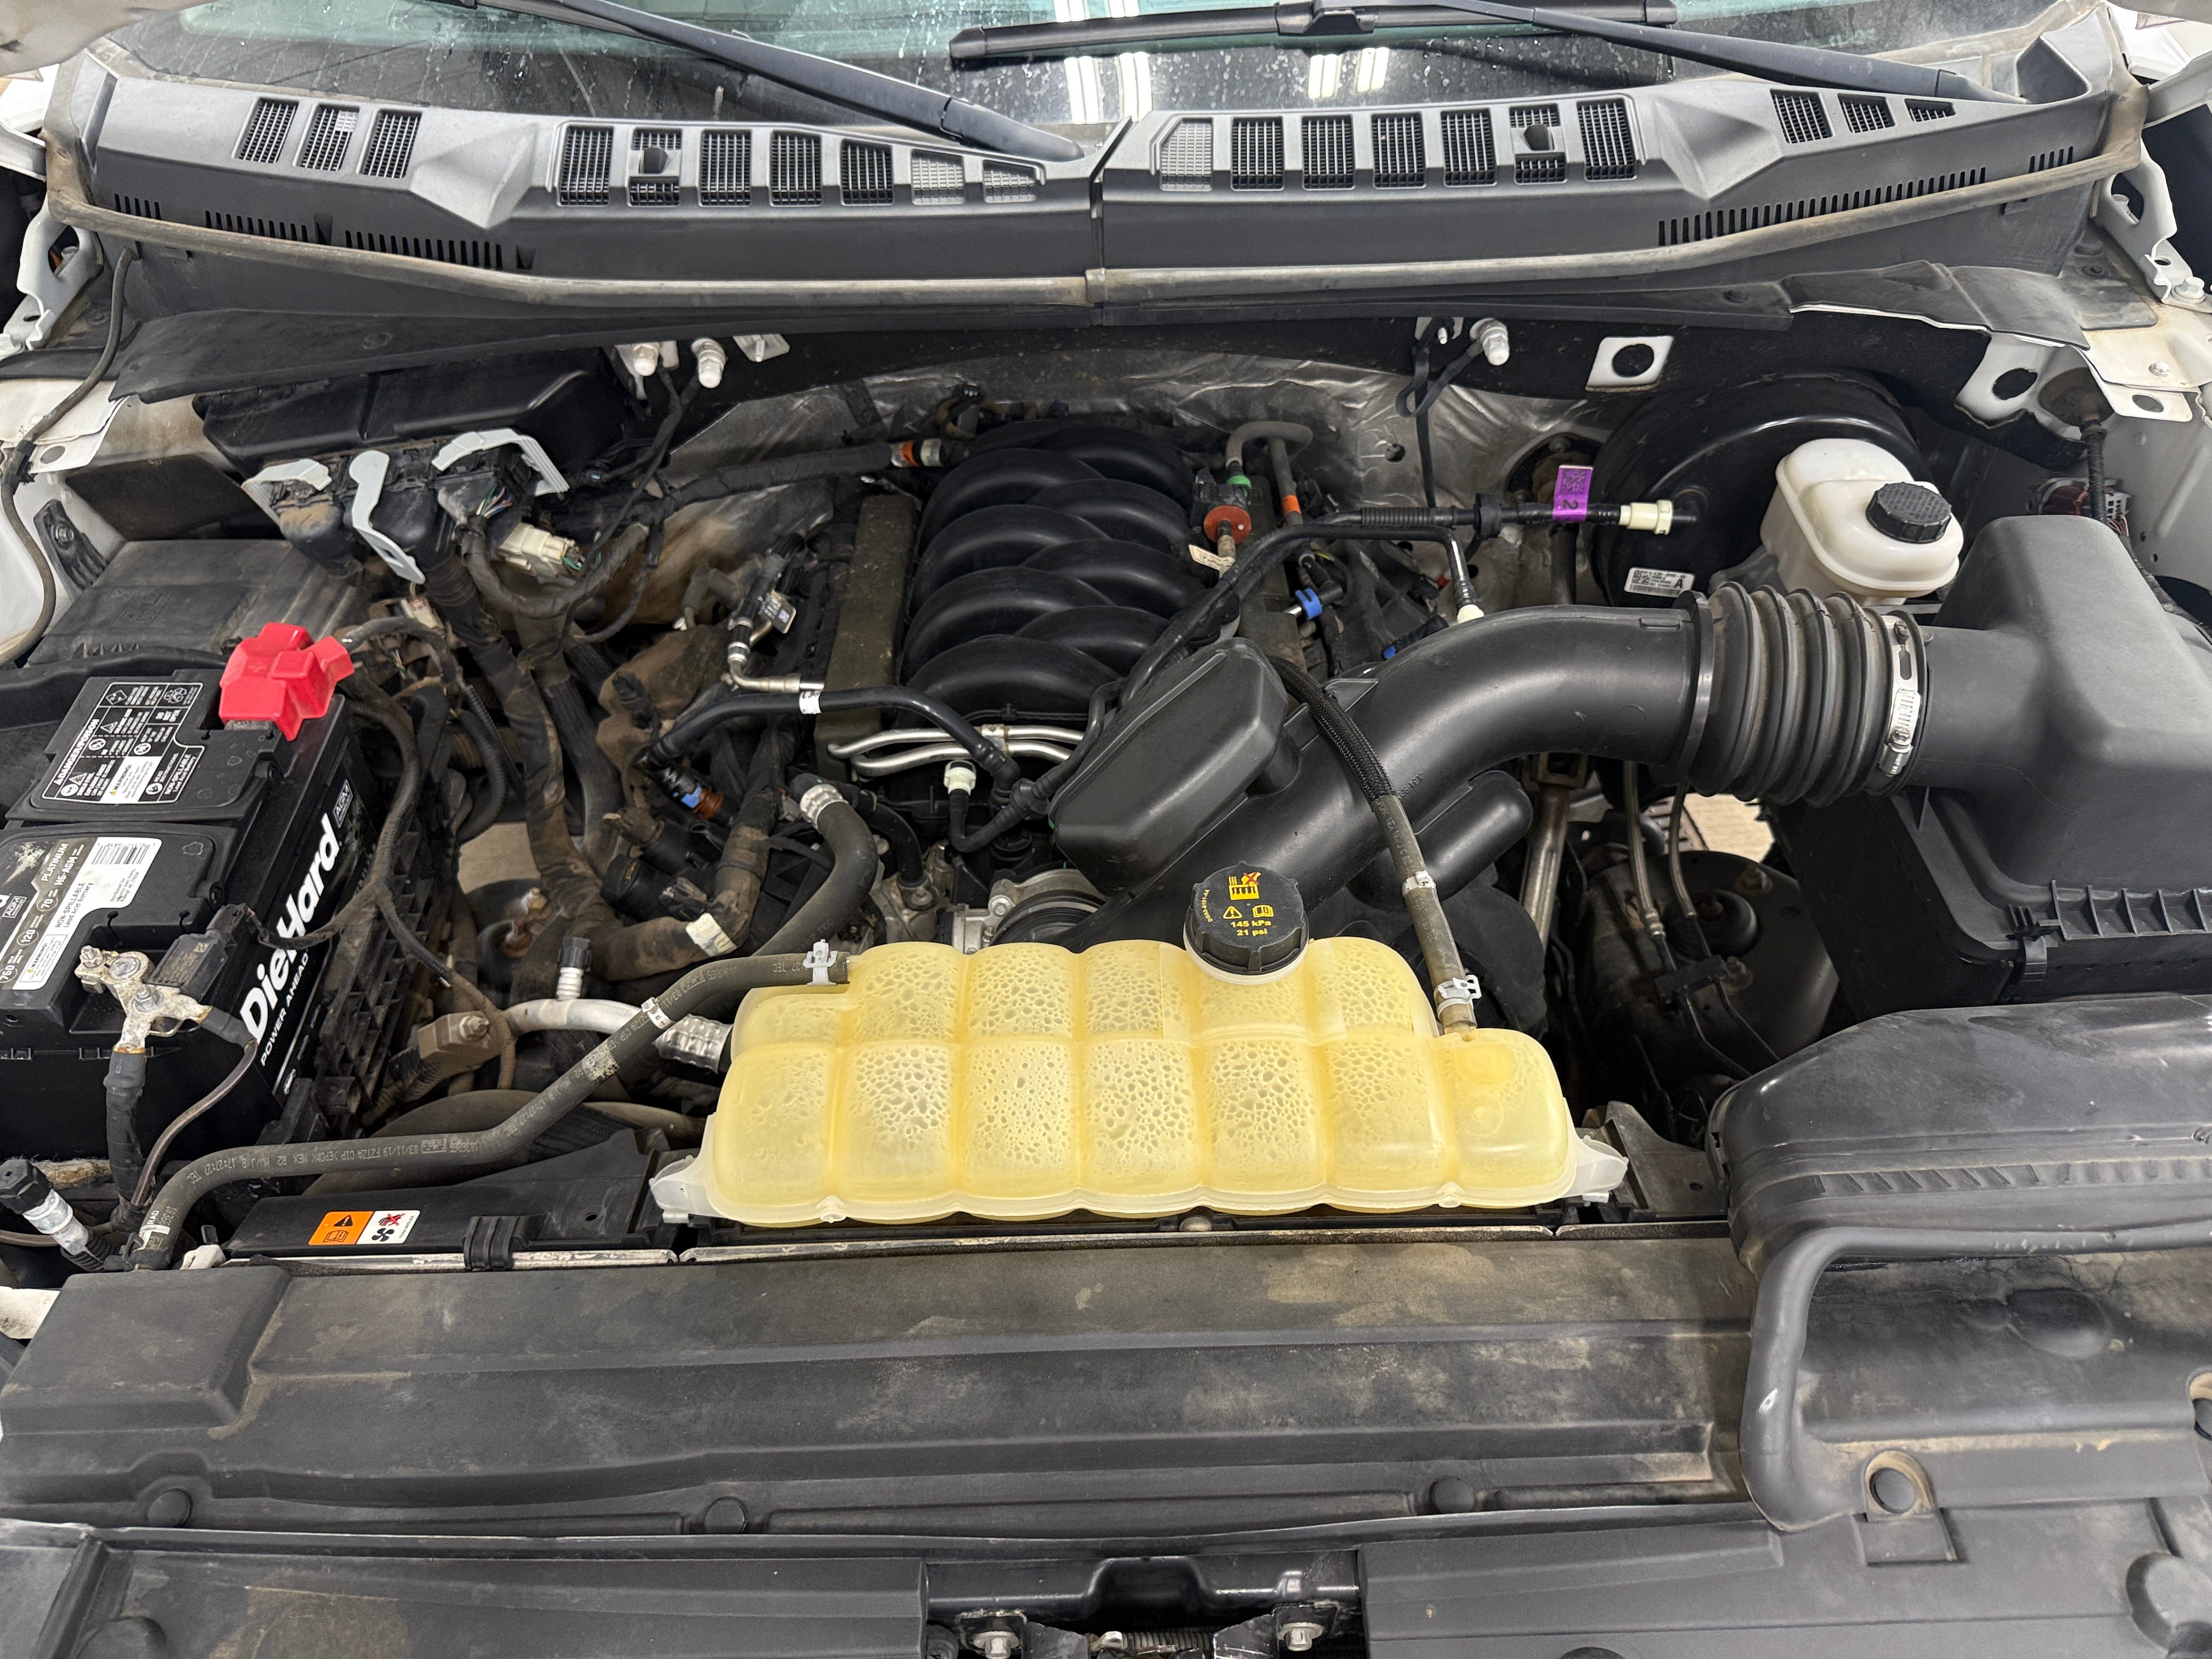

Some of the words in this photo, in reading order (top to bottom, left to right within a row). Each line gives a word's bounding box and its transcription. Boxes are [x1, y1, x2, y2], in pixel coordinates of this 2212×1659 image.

[1564, 500, 1579, 510] 2
[1674, 579, 1683, 588] A
[335, 785, 350, 816] AGM
[41, 843, 69, 882] PLATINUM
[54, 854, 78, 885] H6-AGM
[7, 897, 22, 916] AGM
[41, 898, 54, 909] 70
[55, 882, 85, 928] NON-SPILLABLE
[63, 913, 75, 928] Lead
[72, 899, 82, 916] Acid
[78, 882, 94, 904] Battery
[21, 929, 36, 943] 120
[240, 812, 341, 1045] DieHard
[1252, 928, 1267, 936] psi
[0, 965, 15, 981] 760
[261, 1011, 287, 1067] POWER
[286, 955, 309, 1007] AHEAD
[382, 1144, 419, 1156] 03/11/19
[203, 1158, 235, 1175] 17:27:27
[276, 1155, 286, 1165] B2
[186, 1170, 202, 1184] TEC
[146, 1210, 159, 1224] RAD
